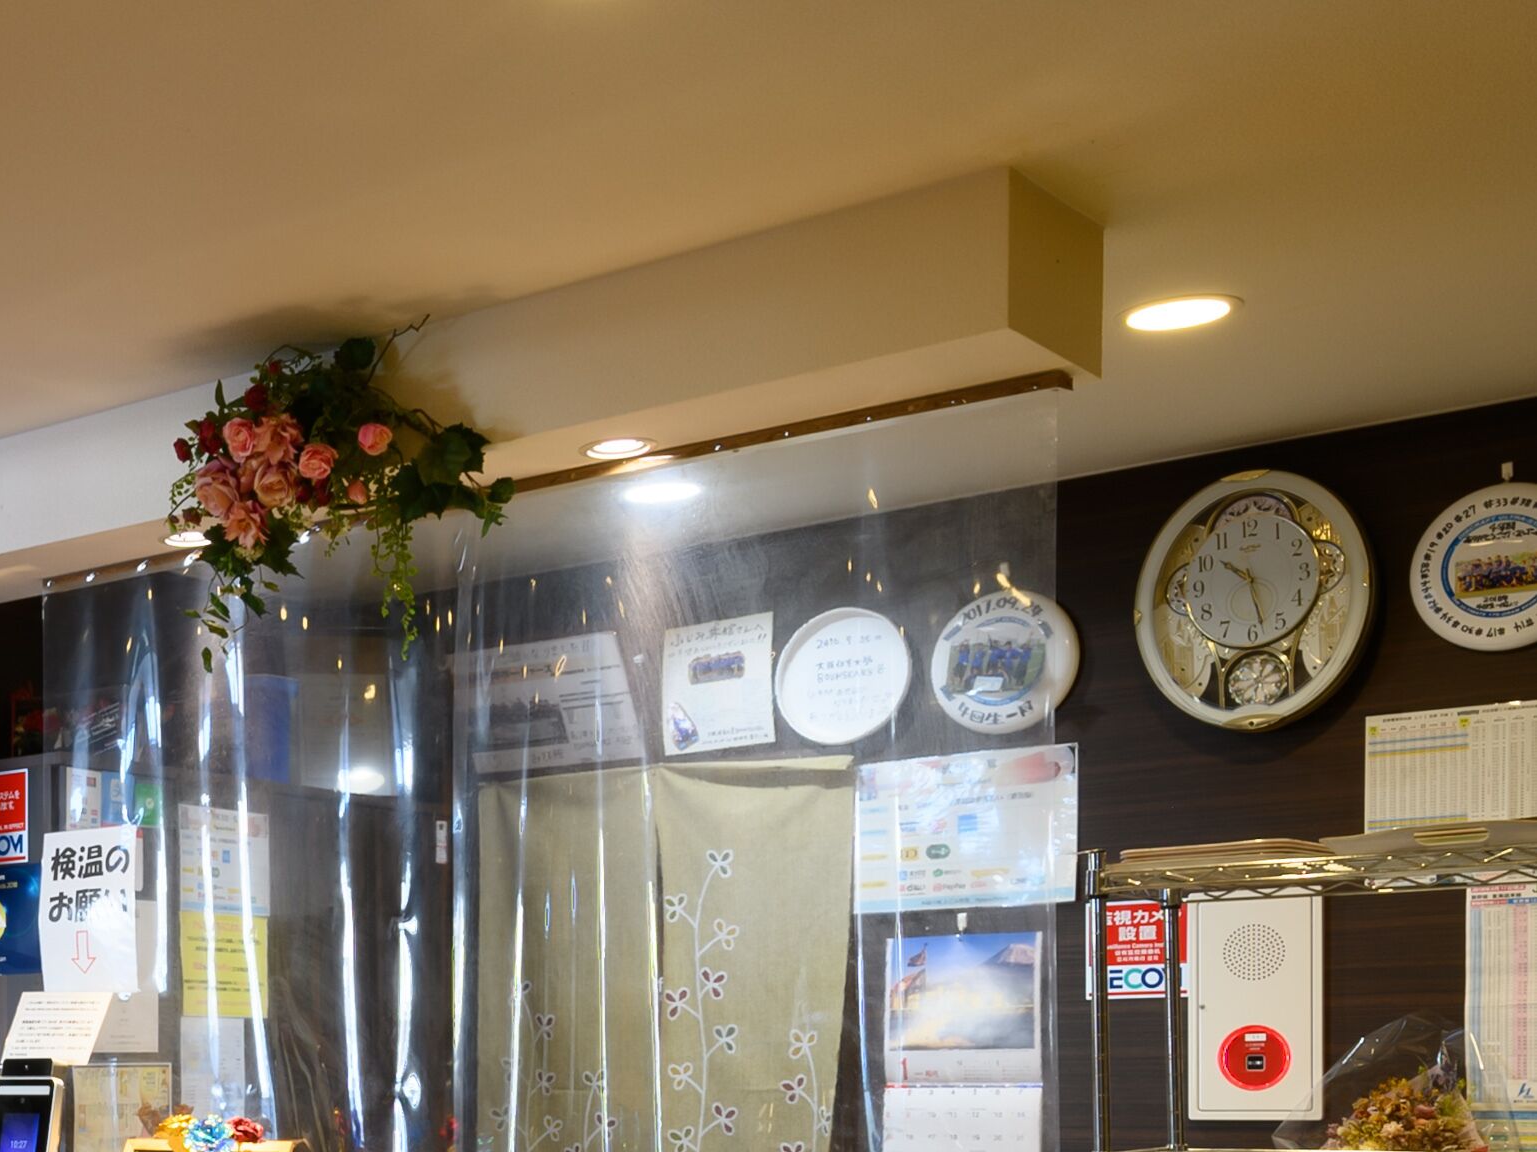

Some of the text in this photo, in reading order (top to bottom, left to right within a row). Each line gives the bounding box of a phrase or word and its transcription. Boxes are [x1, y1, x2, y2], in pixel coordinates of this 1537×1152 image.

[1242, 519, 1259, 538] 12
[1275, 522, 1281, 540] 1
[1215, 532, 1228, 550] 11
[1291, 539, 1303, 556] 2
[1198, 555, 1214, 573] 10
[1299, 562, 1311, 581] 3
[1193, 580, 1205, 598] 9
[1291, 588, 1303, 606] 4
[1201, 603, 1213, 621] 8
[1274, 612, 1287, 630] 5
[1219, 620, 1231, 639] 7
[1247, 624, 1259, 643] 6
[51, 844, 130, 881] 検温の
[1106, 909, 1181, 926] 視カメ
[1118, 925, 1157, 942] 設置
[1109, 967, 1182, 989] ECO
[10, 1140, 28, 1149] 10:27
